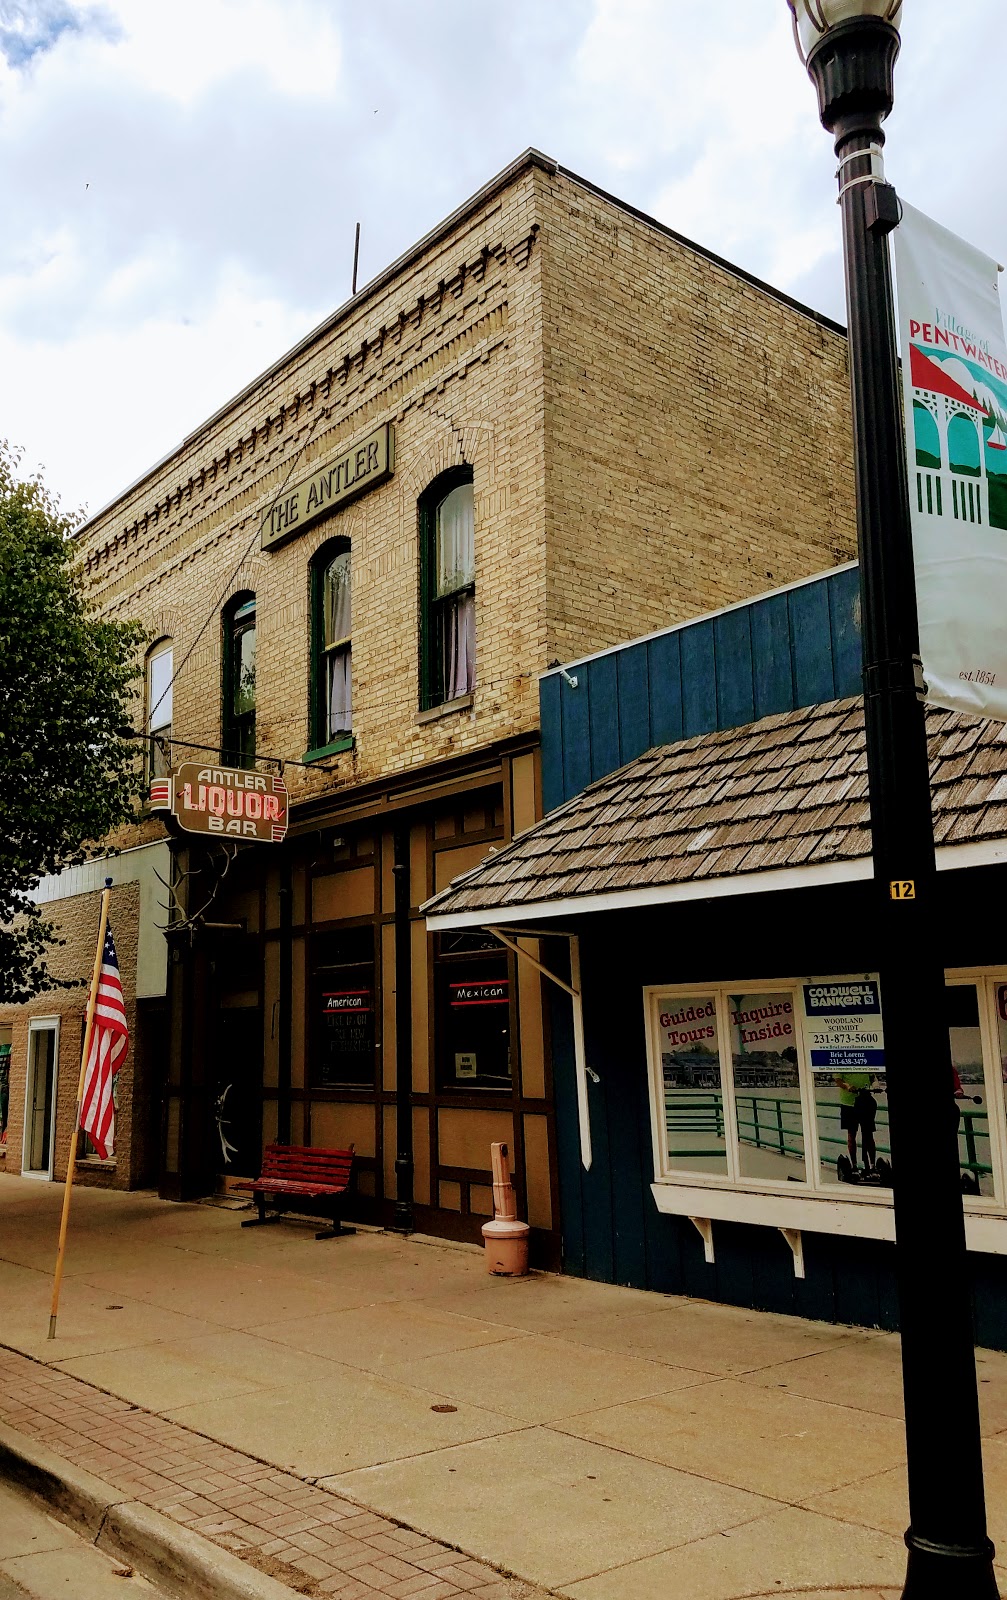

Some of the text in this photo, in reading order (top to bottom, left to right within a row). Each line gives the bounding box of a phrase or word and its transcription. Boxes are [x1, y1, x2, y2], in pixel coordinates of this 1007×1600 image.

[936, 308, 989, 356] Village of
[269, 440, 379, 537] THE ANTLER
[197, 769, 267, 791] ANTLER
[183, 783, 279, 822] LIQUOR
[208, 816, 258, 836] BAR
[892, 882, 914, 898] 12
[457, 986, 504, 999] Mexican
[808, 985, 873, 997] COLDWELL
[327, 996, 362, 1008] American
[810, 996, 862, 1008] BANKER
[659, 1001, 717, 1028] Guided
[731, 1001, 793, 1026] Inquire
[823, 1017, 864, 1025] WOODLAND
[667, 1025, 715, 1046] Tours
[740, 1021, 793, 1044] Inside
[813, 1033, 878, 1044] 231-873-5600
